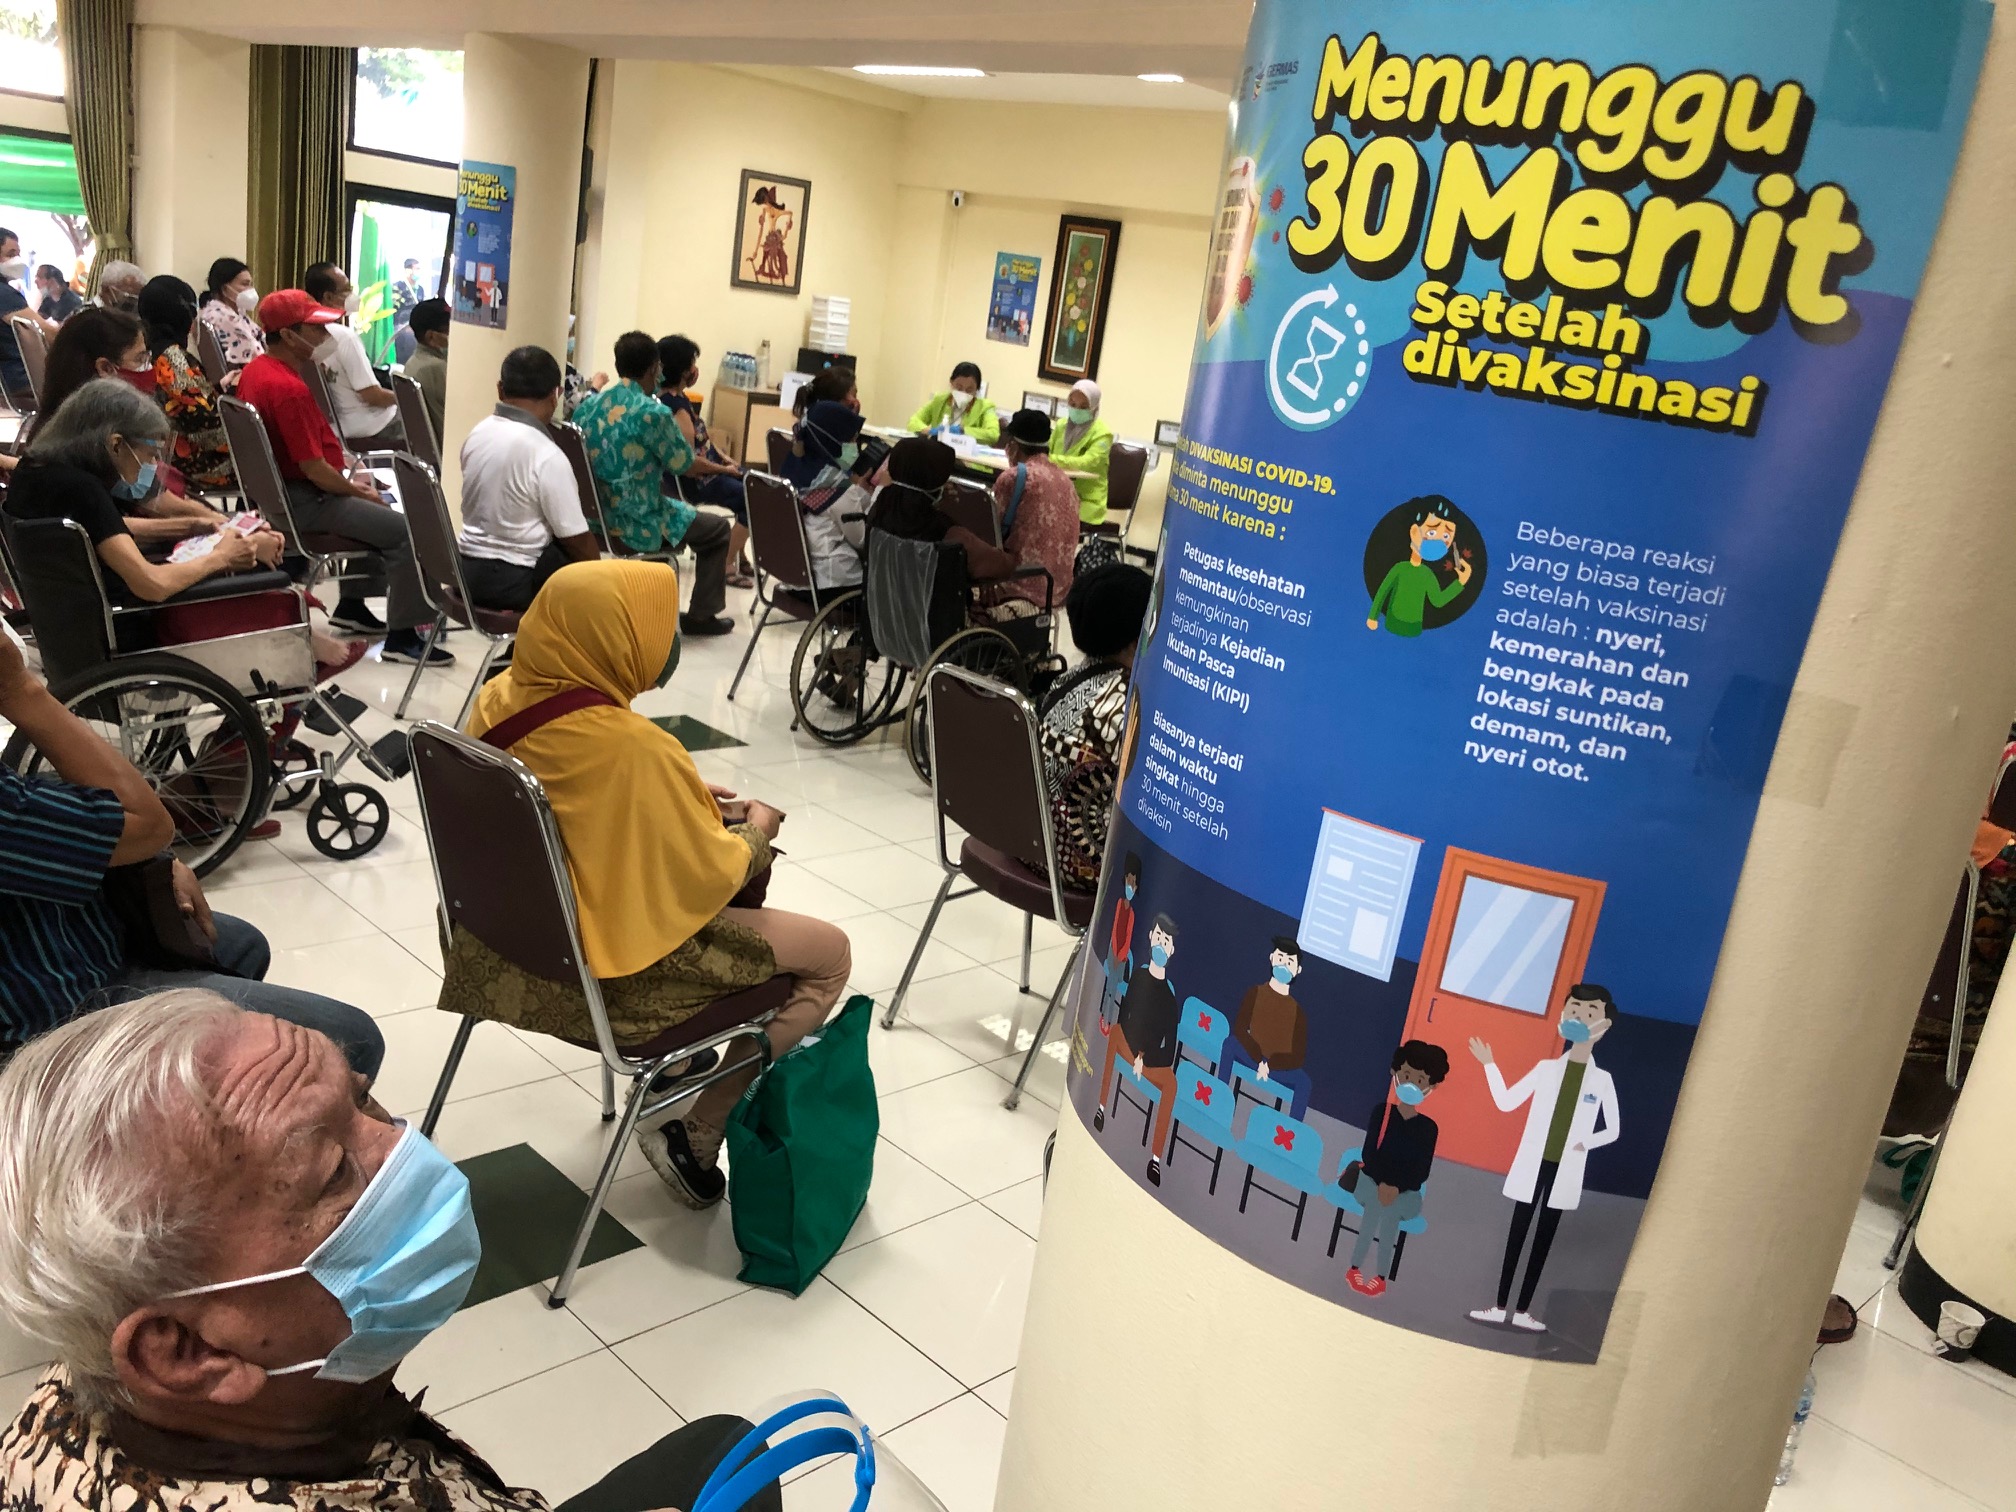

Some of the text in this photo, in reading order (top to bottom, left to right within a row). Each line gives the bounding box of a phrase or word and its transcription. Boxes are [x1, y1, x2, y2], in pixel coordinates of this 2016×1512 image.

[1310, 32, 1808, 185] Menunggu
[468, 180, 507, 200] Menit
[1286, 135, 1864, 328] 30 Menit
[1410, 281, 1642, 357] Setelah
[1402, 331, 1763, 430] divaksinasi
[1179, 460, 1208, 488] diminta
[1209, 477, 1293, 515] menunggu
[1189, 440, 1253, 474] DIVAKSINASI
[1255, 461, 1336, 496] COVID-19.
[1179, 487, 1189, 507] 30
[1190, 495, 1220, 521] menit
[1221, 505, 1276, 538] karena
[1183, 541, 1306, 599] Petugas kesehatan
[1516, 521, 1717, 576] Beberapa reaksi
[1179, 567, 1313, 628] memantau/observasi
[1502, 579, 1709, 633] setelah vaksinasi
[1506, 552, 1727, 607] yang biasa terjadi
[1174, 587, 1249, 633] kemungkinan
[1495, 607, 1578, 639] adalah
[1595, 626, 1667, 658] nyeri,
[1166, 632, 1236, 679] Ikutan Pasca
[1171, 611, 1286, 672] terjadinya Kejadian
[1489, 630, 1690, 688] kemerahan dan
[1162, 654, 1250, 714] Imunisasi (KIPI)
[1482, 657, 1665, 712] bengkak pada
[1153, 709, 1244, 772] Biasanya terjadi
[1470, 712, 1628, 762] demam, dan
[1476, 683, 1673, 746] lokasi suntikan,
[1145, 754, 1225, 814] singkat hingga
[1149, 733, 1218, 785] dalam waktu
[1464, 739, 1590, 783] nyeri otot.
[1137, 797, 1172, 834] divaksin
[1141, 773, 1229, 840] 30 menit setelah
